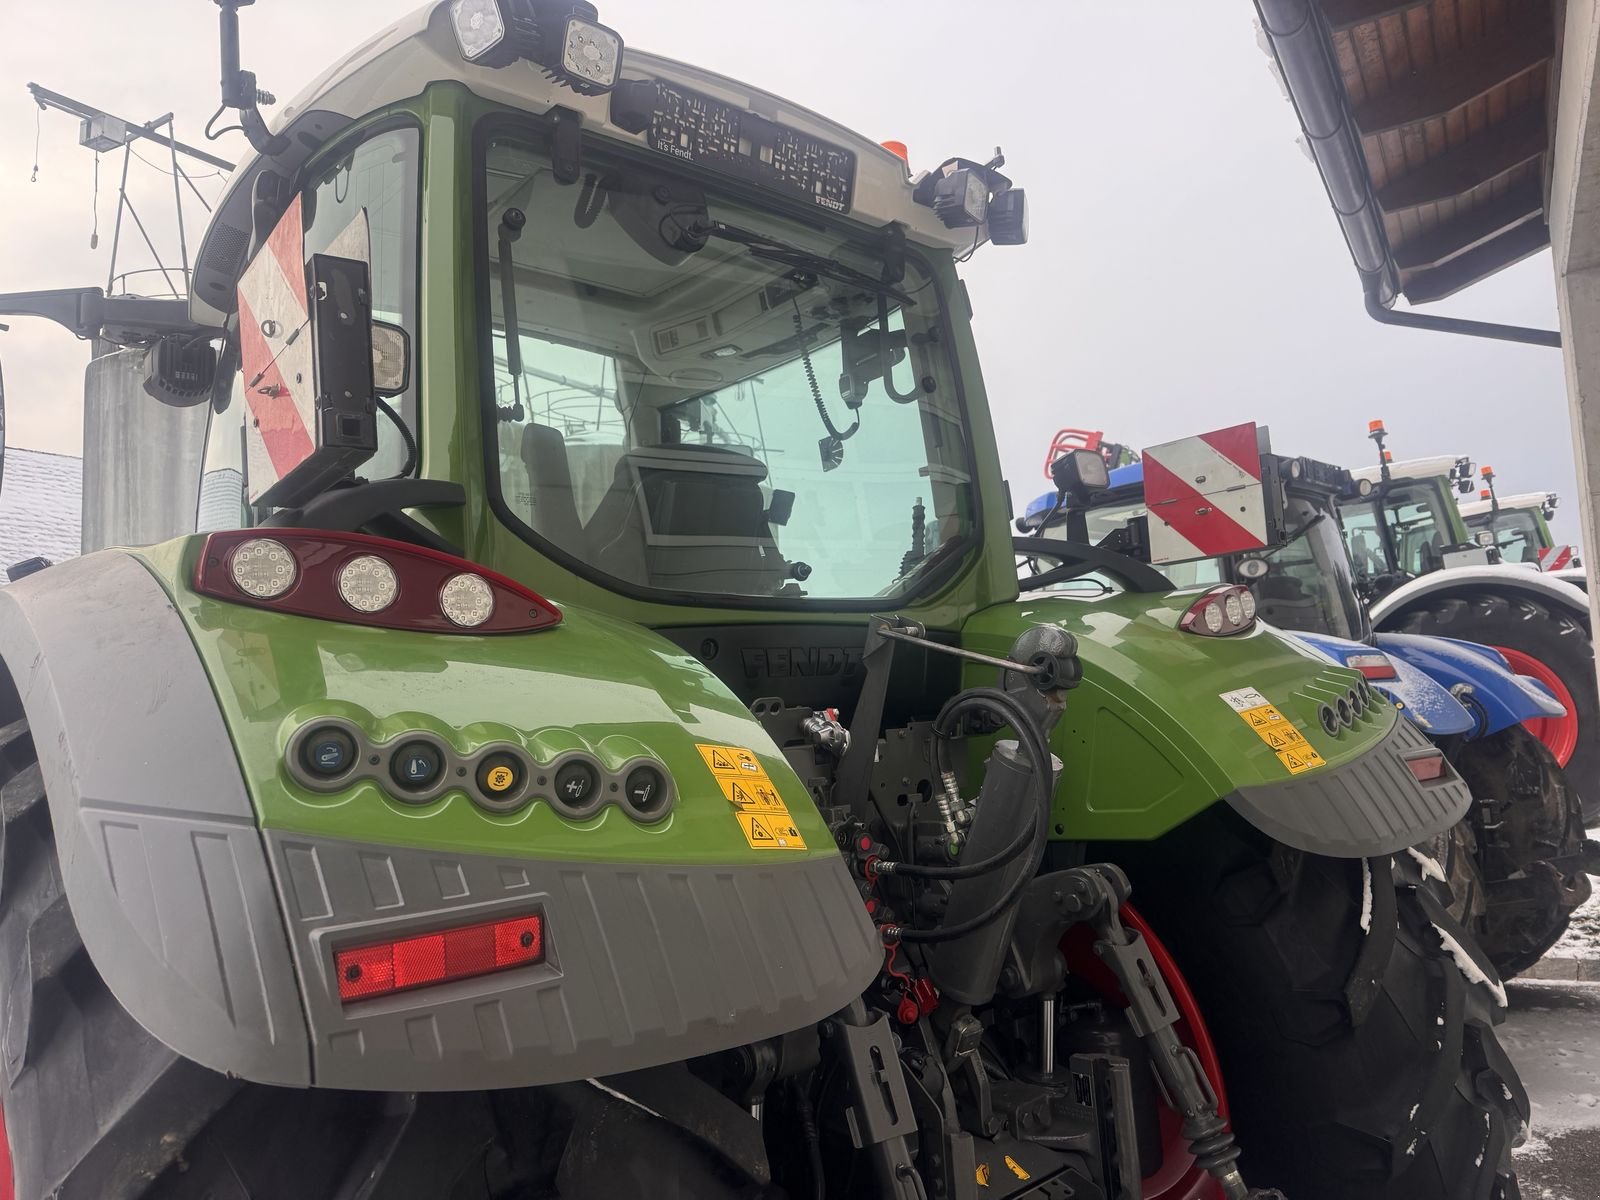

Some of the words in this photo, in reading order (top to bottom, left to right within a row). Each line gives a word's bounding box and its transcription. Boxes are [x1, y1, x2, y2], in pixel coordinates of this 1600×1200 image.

[657, 139, 669, 152] It's
[670, 144, 694, 161] Fendt.
[815, 195, 846, 211] FENDT
[739, 647, 866, 678] FENDT
